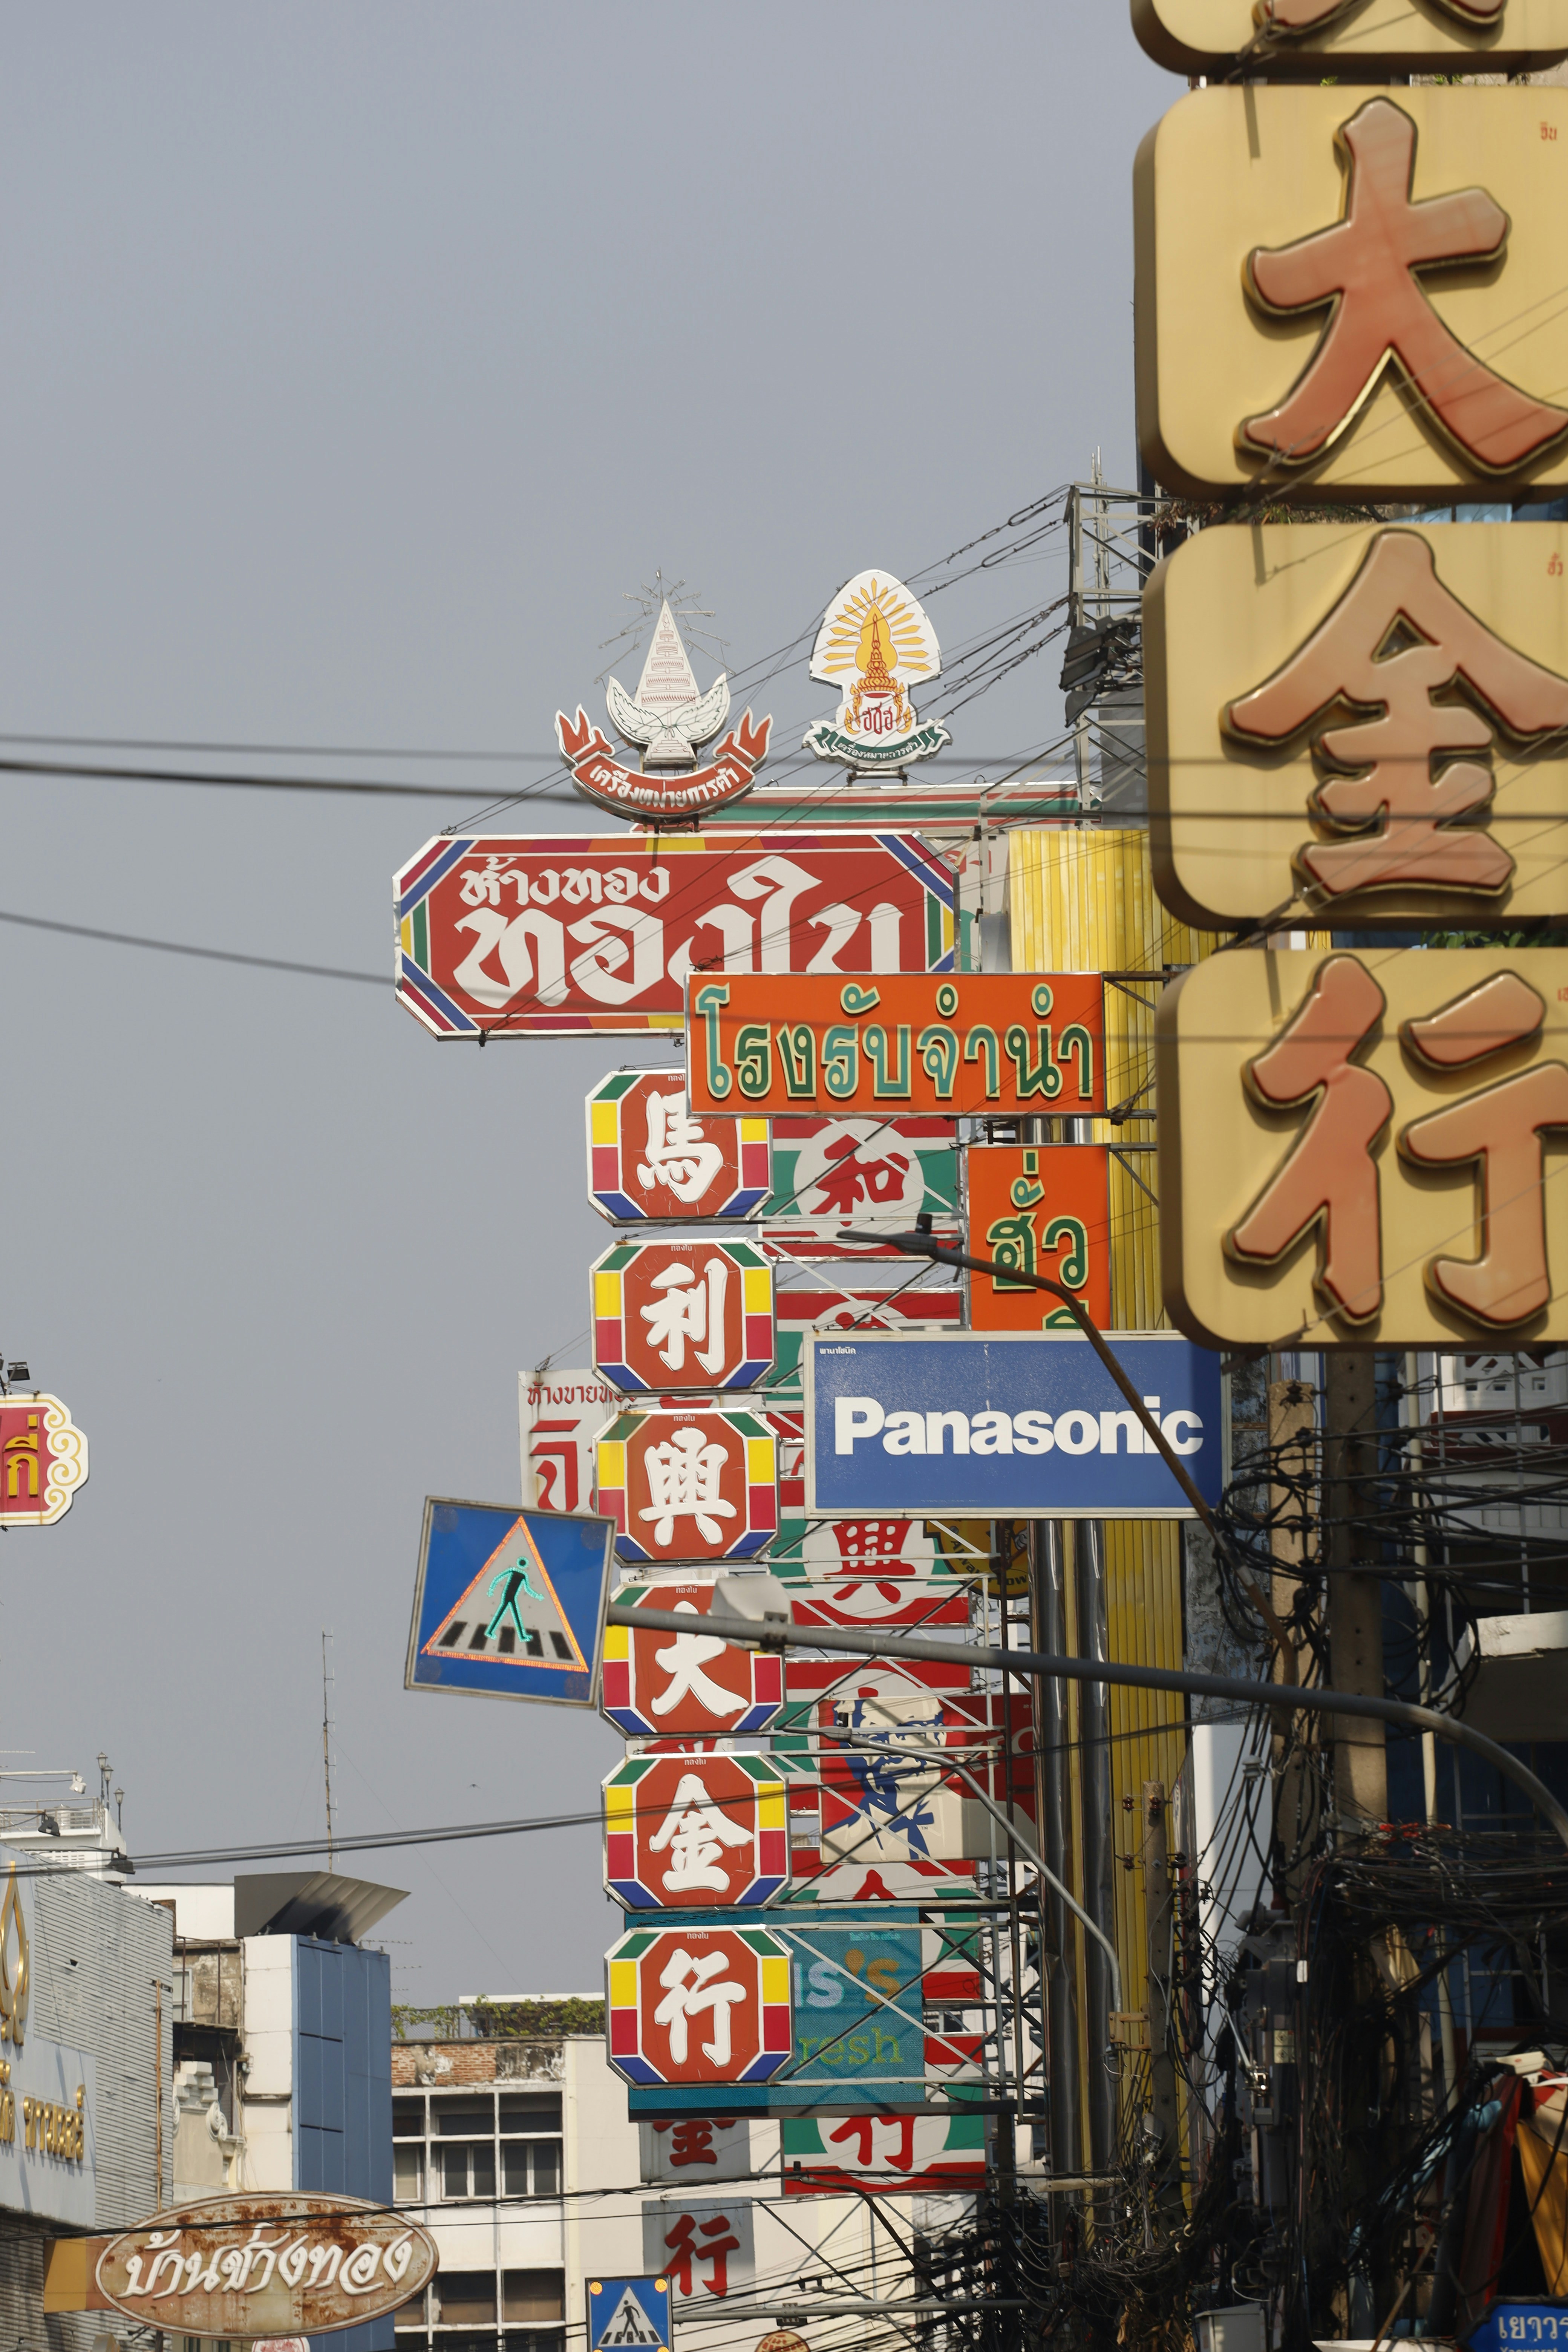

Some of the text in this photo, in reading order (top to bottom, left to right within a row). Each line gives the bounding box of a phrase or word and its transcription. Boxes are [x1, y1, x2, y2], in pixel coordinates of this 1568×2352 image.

[590, 764, 740, 809] เครื่องหมายการค้า
[459, 856, 671, 906] ห้างทอง
[695, 982, 1094, 1099] โรงรับจำนำ
[527, 1381, 637, 1405] ห้างขายท
[834, 1396, 1204, 1455] Panasonic
[0, 1414, 40, 1498] กี่
[798, 2027, 904, 2066] resh
[117, 2222, 414, 2299] บ้านช่างทอง
